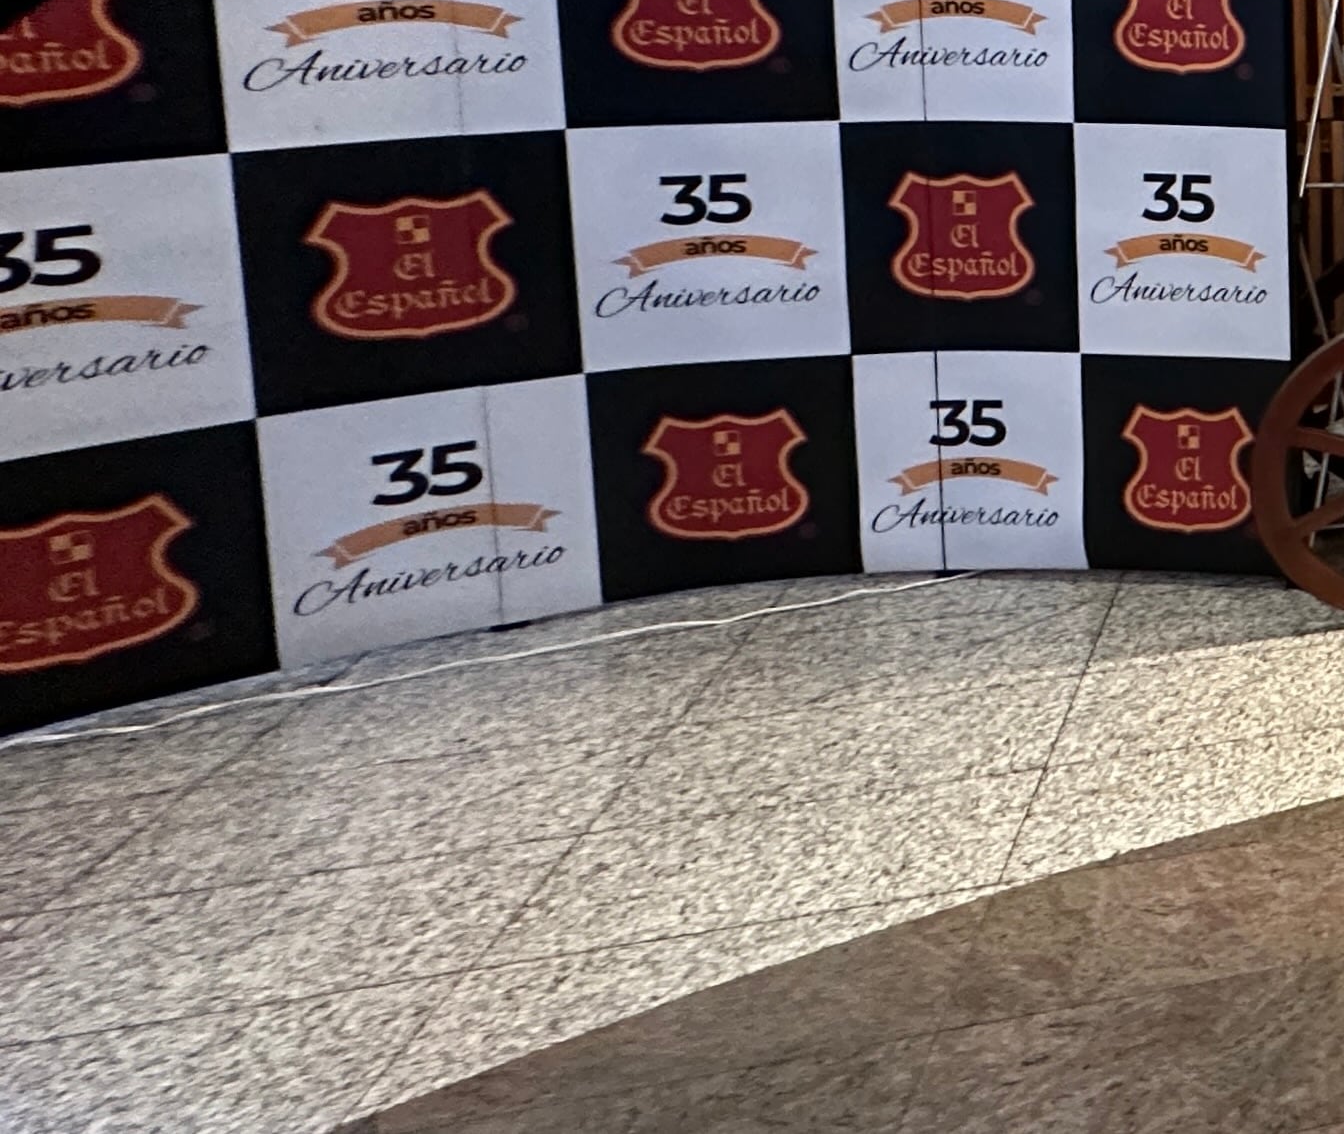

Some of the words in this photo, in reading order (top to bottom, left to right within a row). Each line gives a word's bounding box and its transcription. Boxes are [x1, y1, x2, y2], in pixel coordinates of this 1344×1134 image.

[356, 0, 436, 23] años
[629, 17, 760, 50] Español
[1128, 22, 1229, 51] Español
[243, 49, 527, 92] Aniversario
[849, 36, 1049, 72] Aniversario
[658, 174, 752, 226] 35
[1140, 173, 1215, 224] 35
[683, 236, 746, 256] años
[950, 223, 980, 250] El
[1158, 234, 1209, 254] años
[393, 250, 436, 280] El
[906, 250, 1018, 281] Español
[331, 279, 495, 318] Español
[594, 280, 820, 319] Aniversario
[1090, 271, 1268, 306] Aniversario
[929, 399, 1007, 448] 35
[370, 441, 484, 506] 35
[710, 462, 745, 488] El
[951, 457, 1001, 477] años
[1175, 454, 1203, 482] El
[665, 486, 790, 522] Español
[1136, 482, 1242, 512] Español
[402, 509, 478, 537] años
[871, 498, 1059, 533] Aniversario
[49, 568, 100, 602] El
[293, 545, 566, 618] Aniversario
